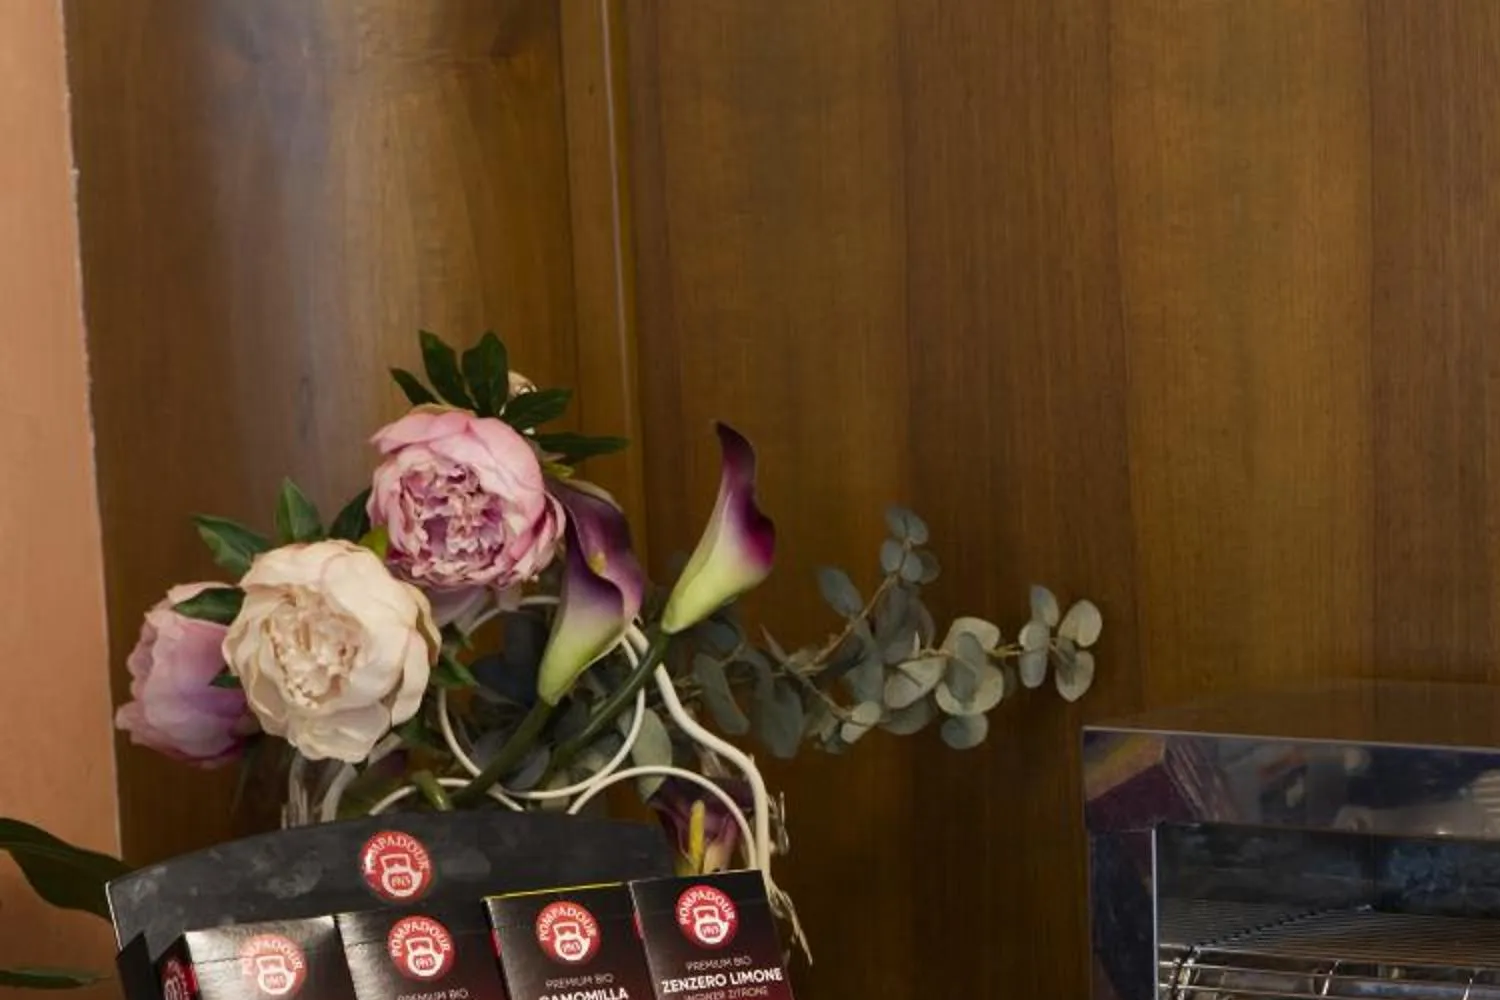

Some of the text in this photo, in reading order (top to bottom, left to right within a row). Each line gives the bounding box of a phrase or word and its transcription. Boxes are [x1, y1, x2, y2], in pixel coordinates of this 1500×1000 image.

[680, 890, 735, 925] POMPADOUR
[392, 921, 451, 957] POMPADOUR
[661, 967, 783, 993] ZENZERO LIMONE
